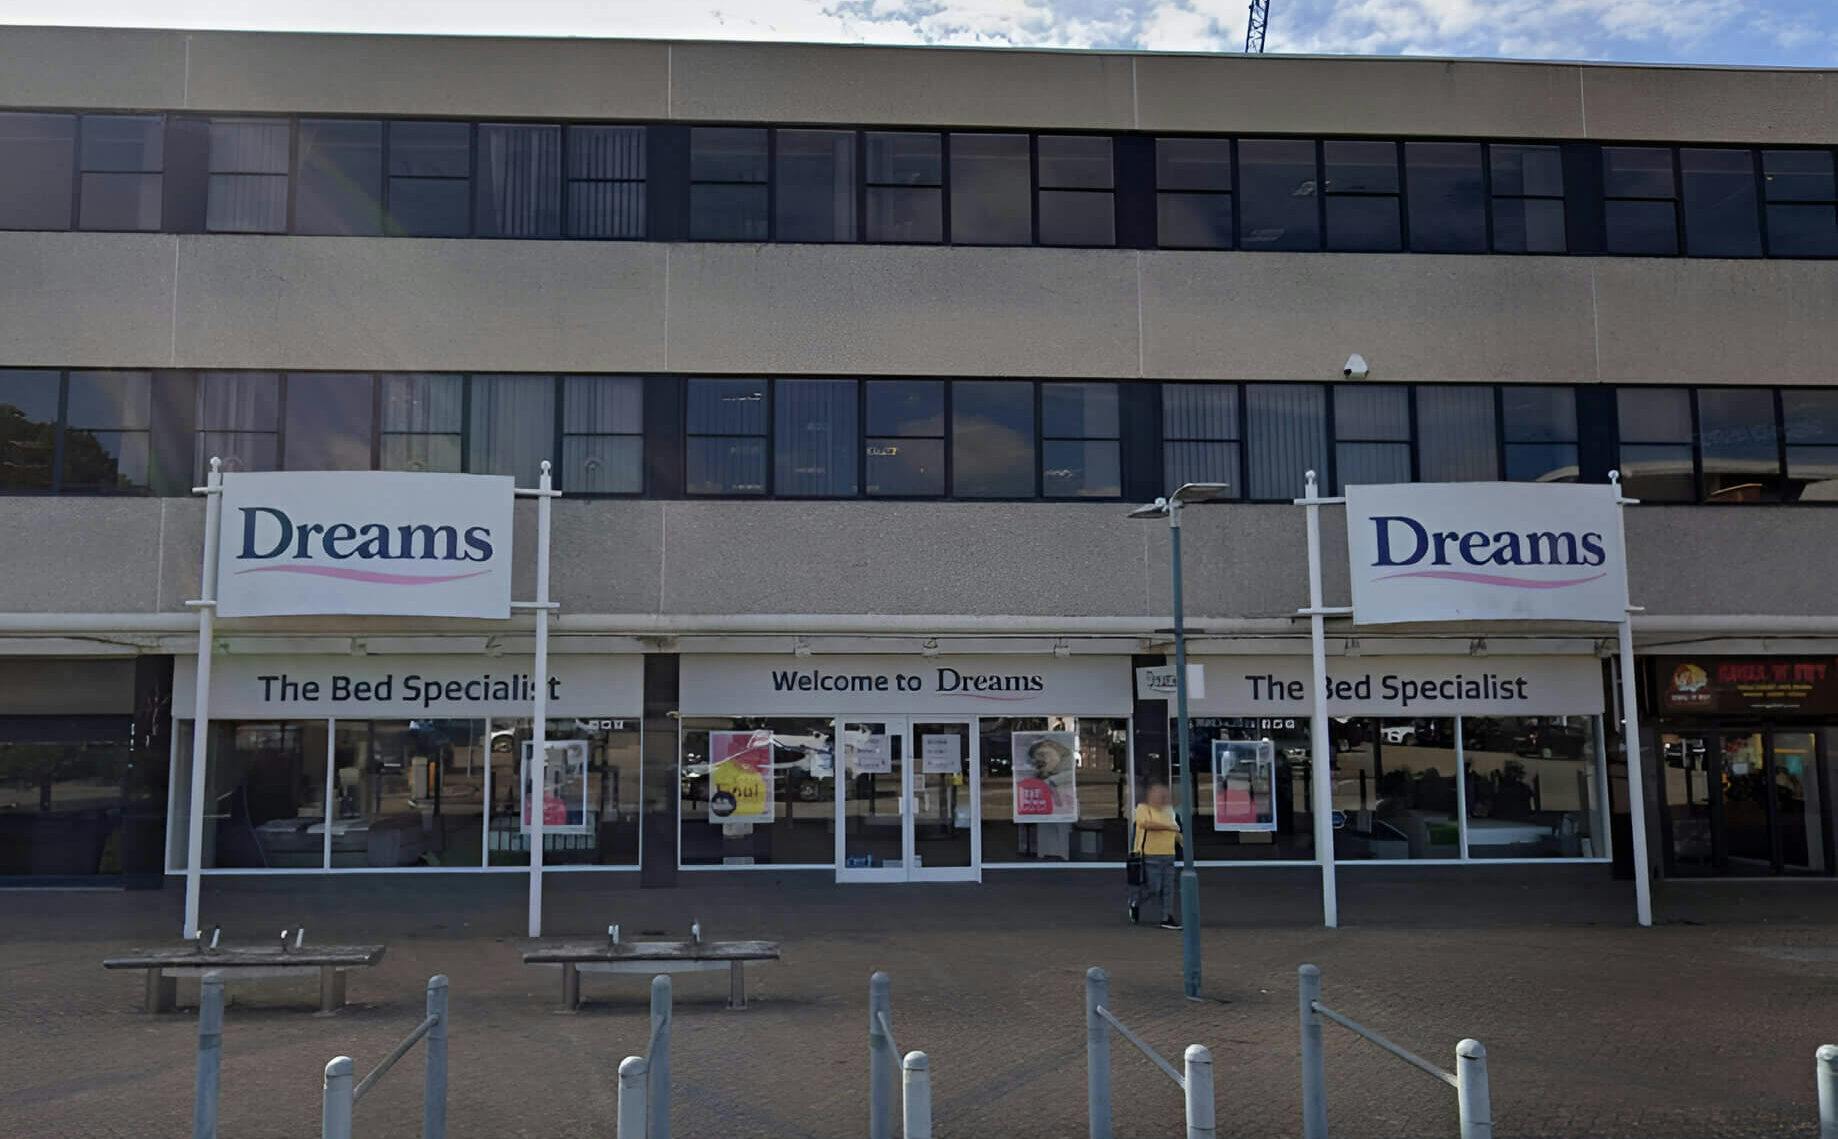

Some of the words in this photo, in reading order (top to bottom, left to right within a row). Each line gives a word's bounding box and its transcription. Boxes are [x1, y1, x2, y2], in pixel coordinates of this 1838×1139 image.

[235, 506, 494, 562] Dreams
[1368, 515, 1607, 567] Dreams
[257, 673, 320, 702] The
[331, 673, 393, 702] Bed
[771, 669, 889, 692] Welcome
[895, 673, 922, 692] to
[935, 667, 1044, 692] Dreams
[1244, 673, 1305, 701] The
[1381, 673, 1529, 707] Specialist
